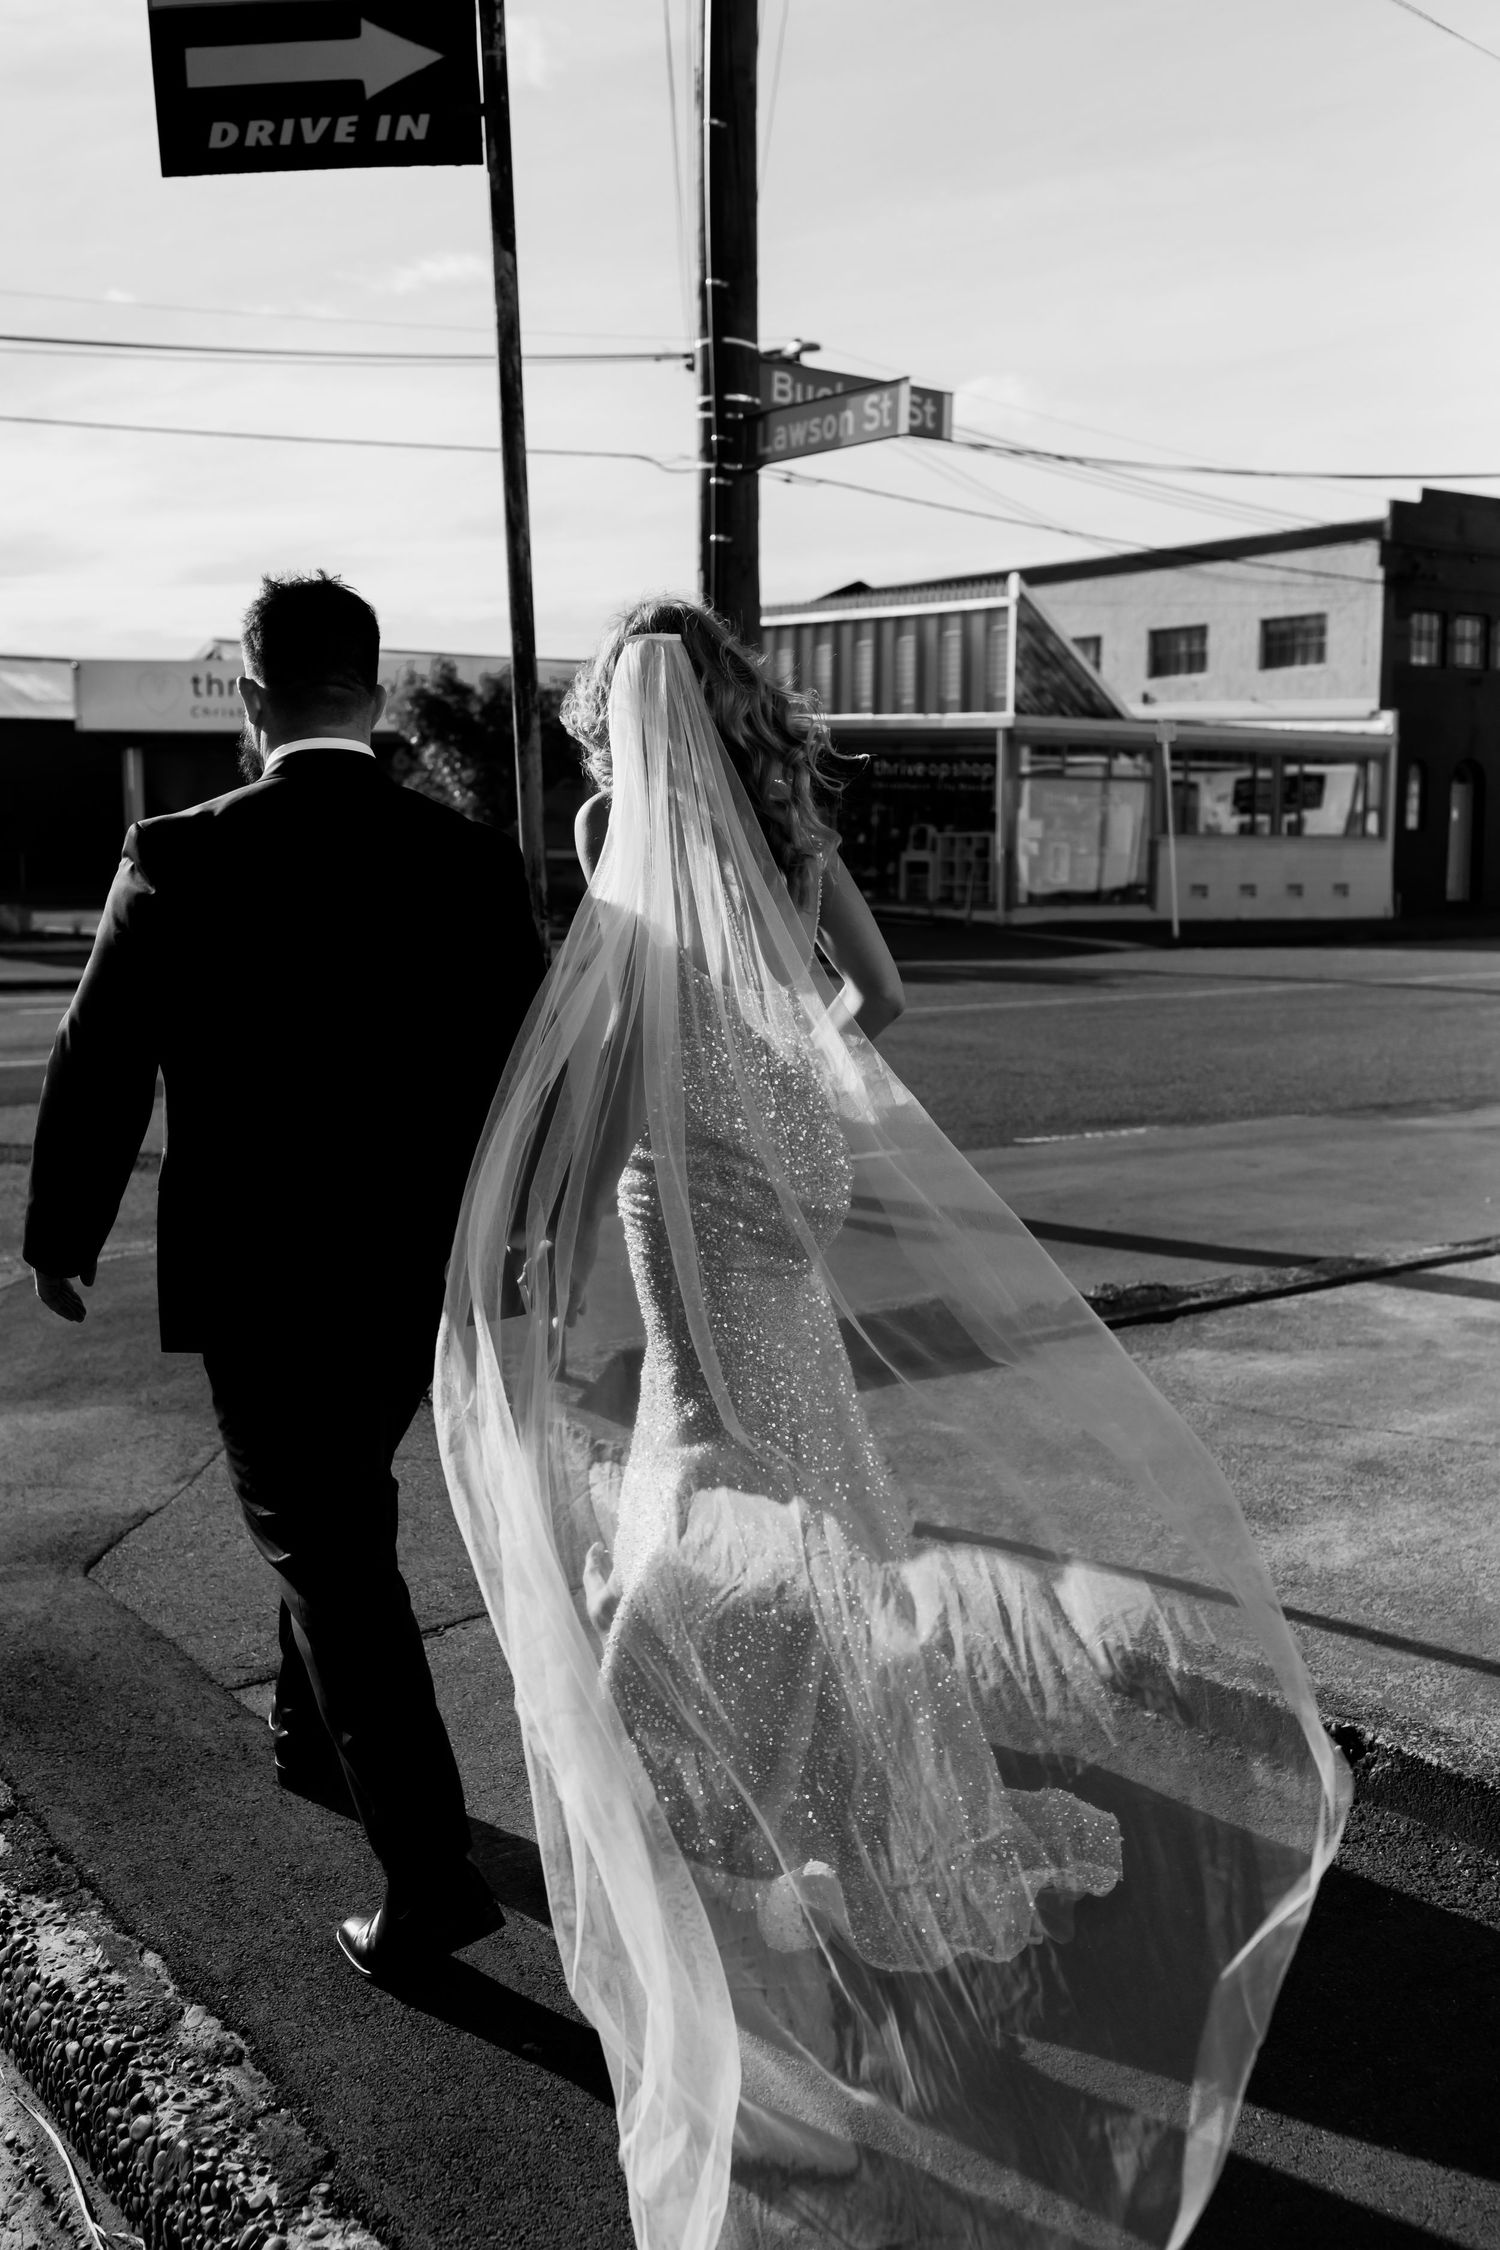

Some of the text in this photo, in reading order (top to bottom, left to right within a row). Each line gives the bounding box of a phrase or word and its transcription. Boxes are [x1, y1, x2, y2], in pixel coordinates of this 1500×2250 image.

[208, 113, 430, 149] DRIVE IN
[758, 389, 893, 455] Lawson St
[909, 394, 938, 429] St
